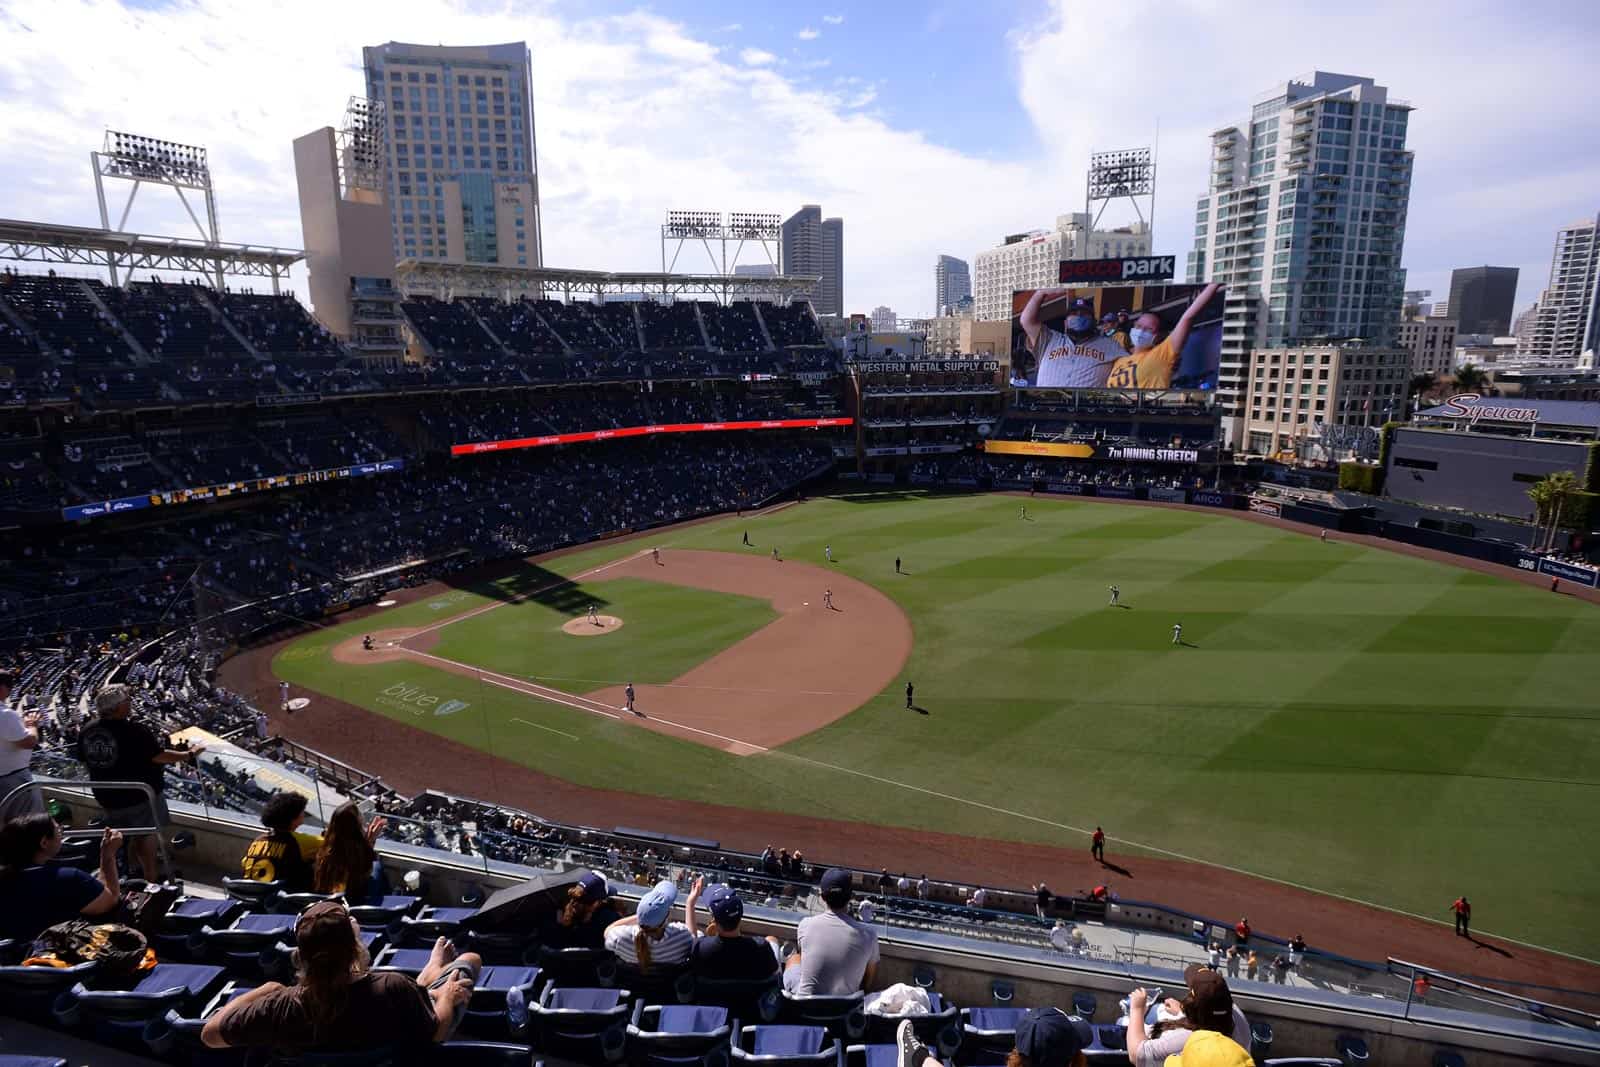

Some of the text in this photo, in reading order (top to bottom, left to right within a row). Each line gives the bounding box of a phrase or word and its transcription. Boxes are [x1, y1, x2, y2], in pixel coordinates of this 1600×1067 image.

[1061, 255, 1173, 281] petco park
[1048, 347, 1105, 362] SAN DIEGO
[860, 361, 999, 373] WESTERN METAL SUPPLY CO.
[1442, 393, 1541, 425] Sycuan
[1122, 447, 1155, 460] INNING
[1156, 449, 1198, 462] STRETCH
[1518, 558, 1536, 570] 396
